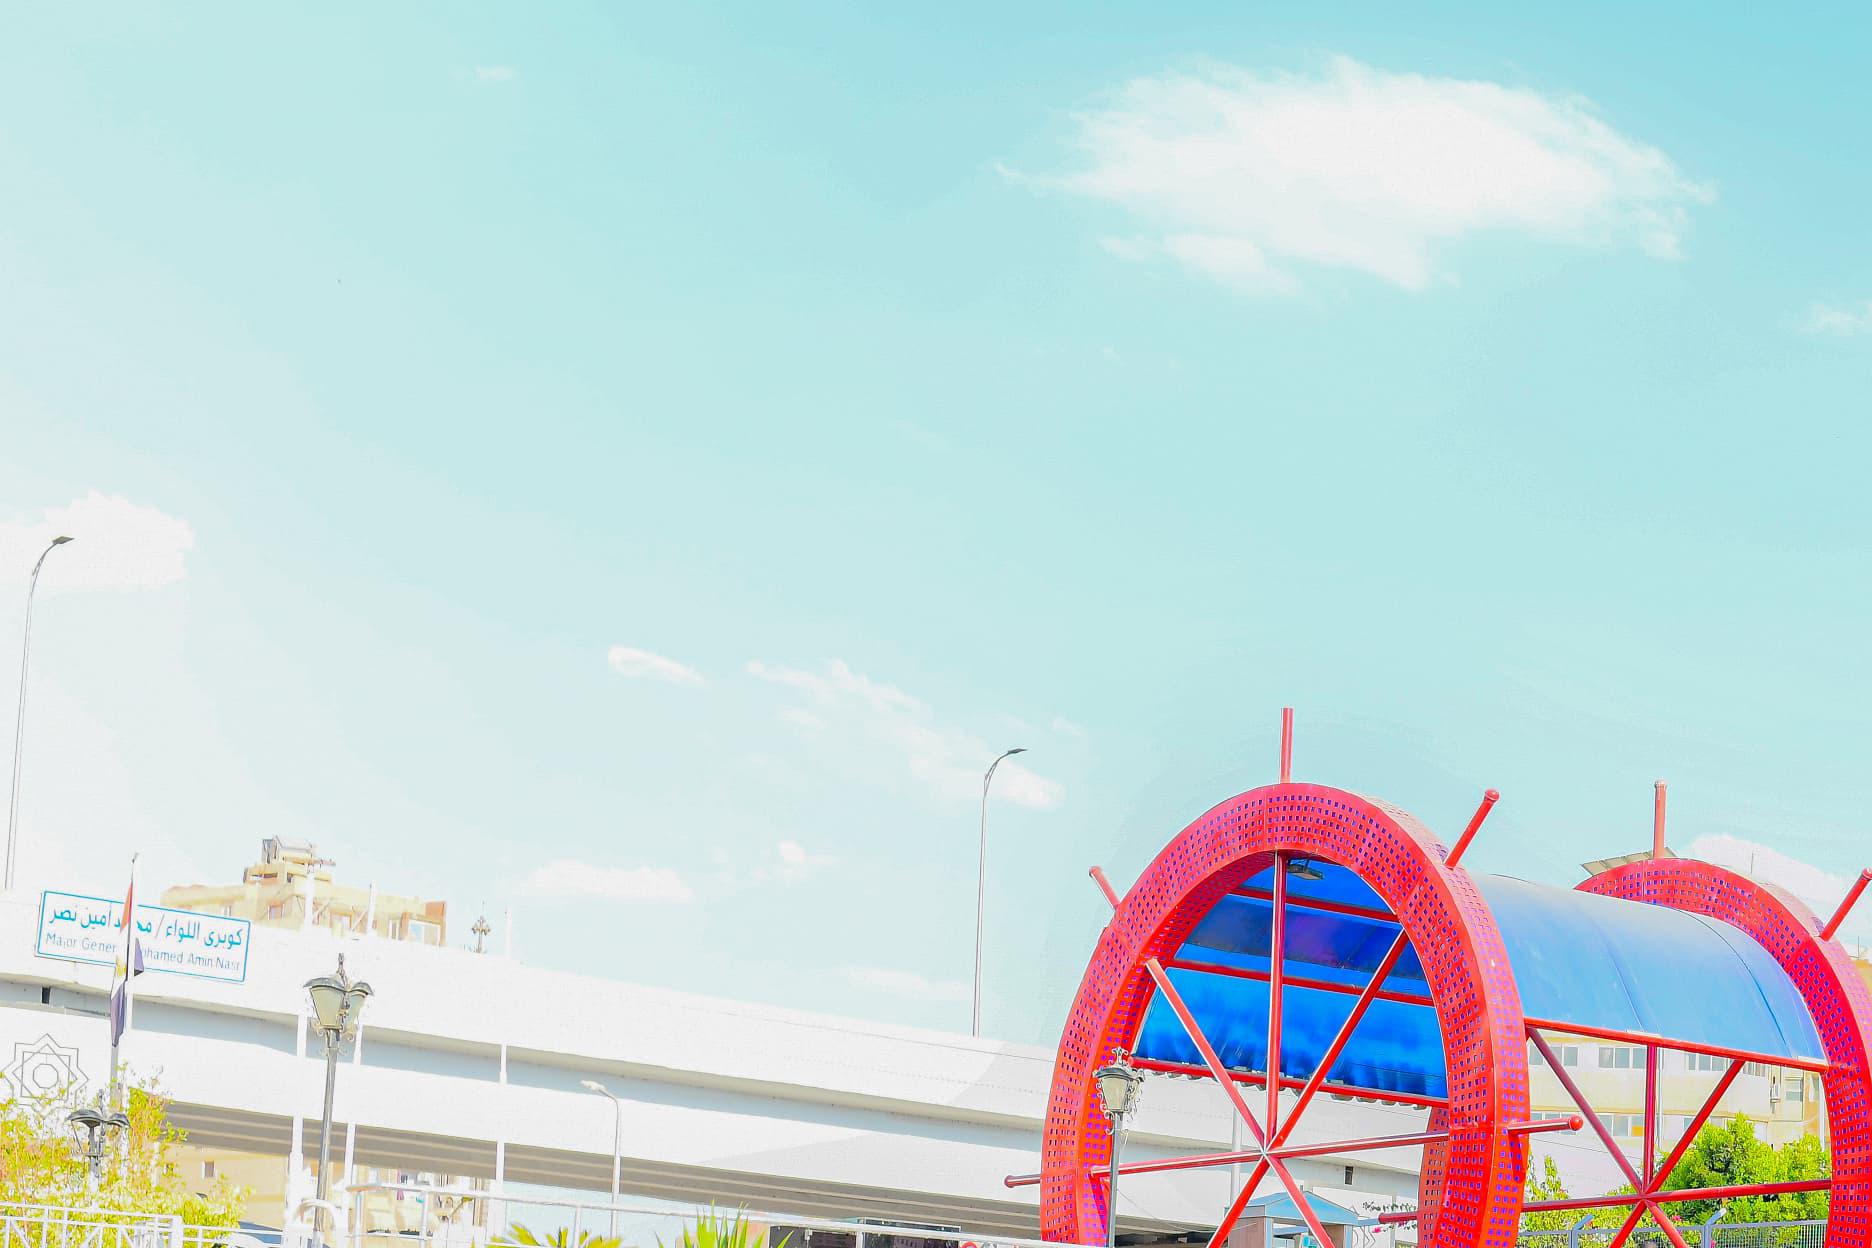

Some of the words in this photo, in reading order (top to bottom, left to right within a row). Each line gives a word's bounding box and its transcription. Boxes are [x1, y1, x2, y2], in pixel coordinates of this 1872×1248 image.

[49, 905, 77, 924] نصر
[165, 919, 200, 943] اللواء
[46, 932, 77, 949] Major
[81, 937, 118, 953] Gener
[187, 953, 213, 967] Amin
